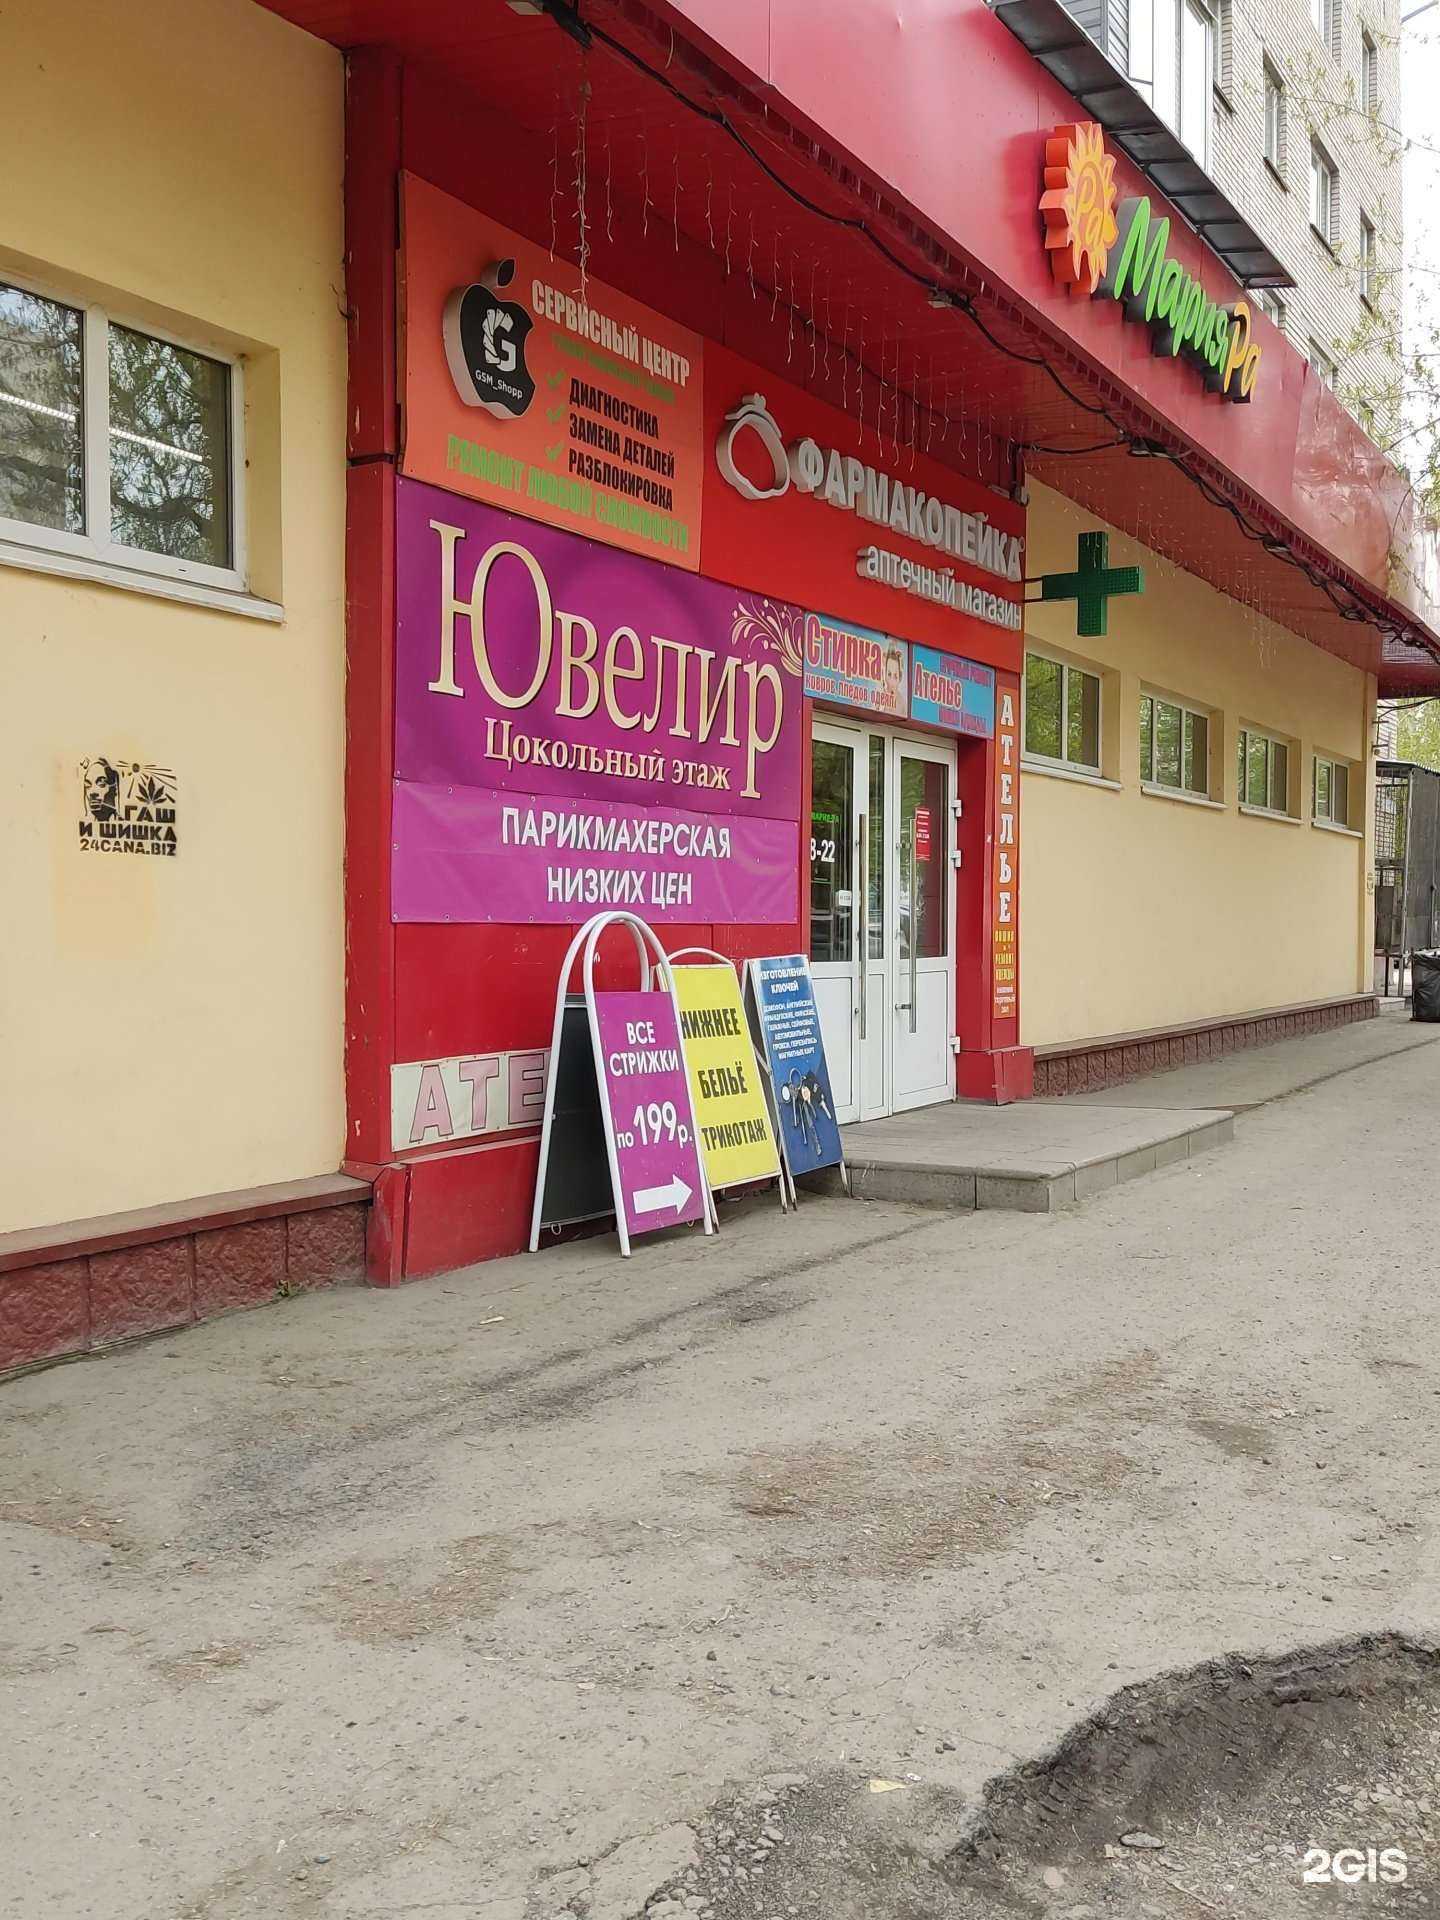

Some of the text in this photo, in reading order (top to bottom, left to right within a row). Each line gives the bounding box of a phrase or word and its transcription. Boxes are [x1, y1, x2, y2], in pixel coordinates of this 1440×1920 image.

[531, 280, 640, 365] СЕРВИСНЫЙ
[642, 336, 690, 388] ЦЕНТР
[569, 378, 659, 440] ДИАГНОСТИКА
[569, 413, 675, 479] ЗАМЕНА ДЕТАЛЕЙ
[569, 448, 673, 511] РАЗБЛОКИРОВКА
[796, 437, 1022, 581] ФАРМАКОПЕЙКА
[863, 545, 1021, 630] аптечный магазин
[428, 518, 784, 798] Ювелир
[805, 613, 883, 682] Стирка
[914, 662, 963, 709] Ателье
[484, 717, 732, 790] Цокольный этаж
[79, 821, 177, 842] И ШИШКА
[124, 805, 176, 823] ГАШ
[999, 694, 1014, 923] АТЕЛЬЕ
[80, 838, 176, 856] 24CANA.BIZ
[502, 807, 731, 859] ПАРИКМАХЕРСКАЯ
[546, 866, 692, 910] НИЗКИХ ЦЕН
[771, 980, 799, 994] КЛЮЧЕЙ
[627, 1021, 656, 1045] ВСЕ
[681, 1008, 741, 1039] НИЖНЕЕ
[609, 1050, 679, 1076] СТРИЖКИ
[698, 1061, 748, 1099] БЕЛЬЁ
[617, 1131, 635, 1150] по
[701, 1118, 767, 1152] ТРИКОТАЖ
